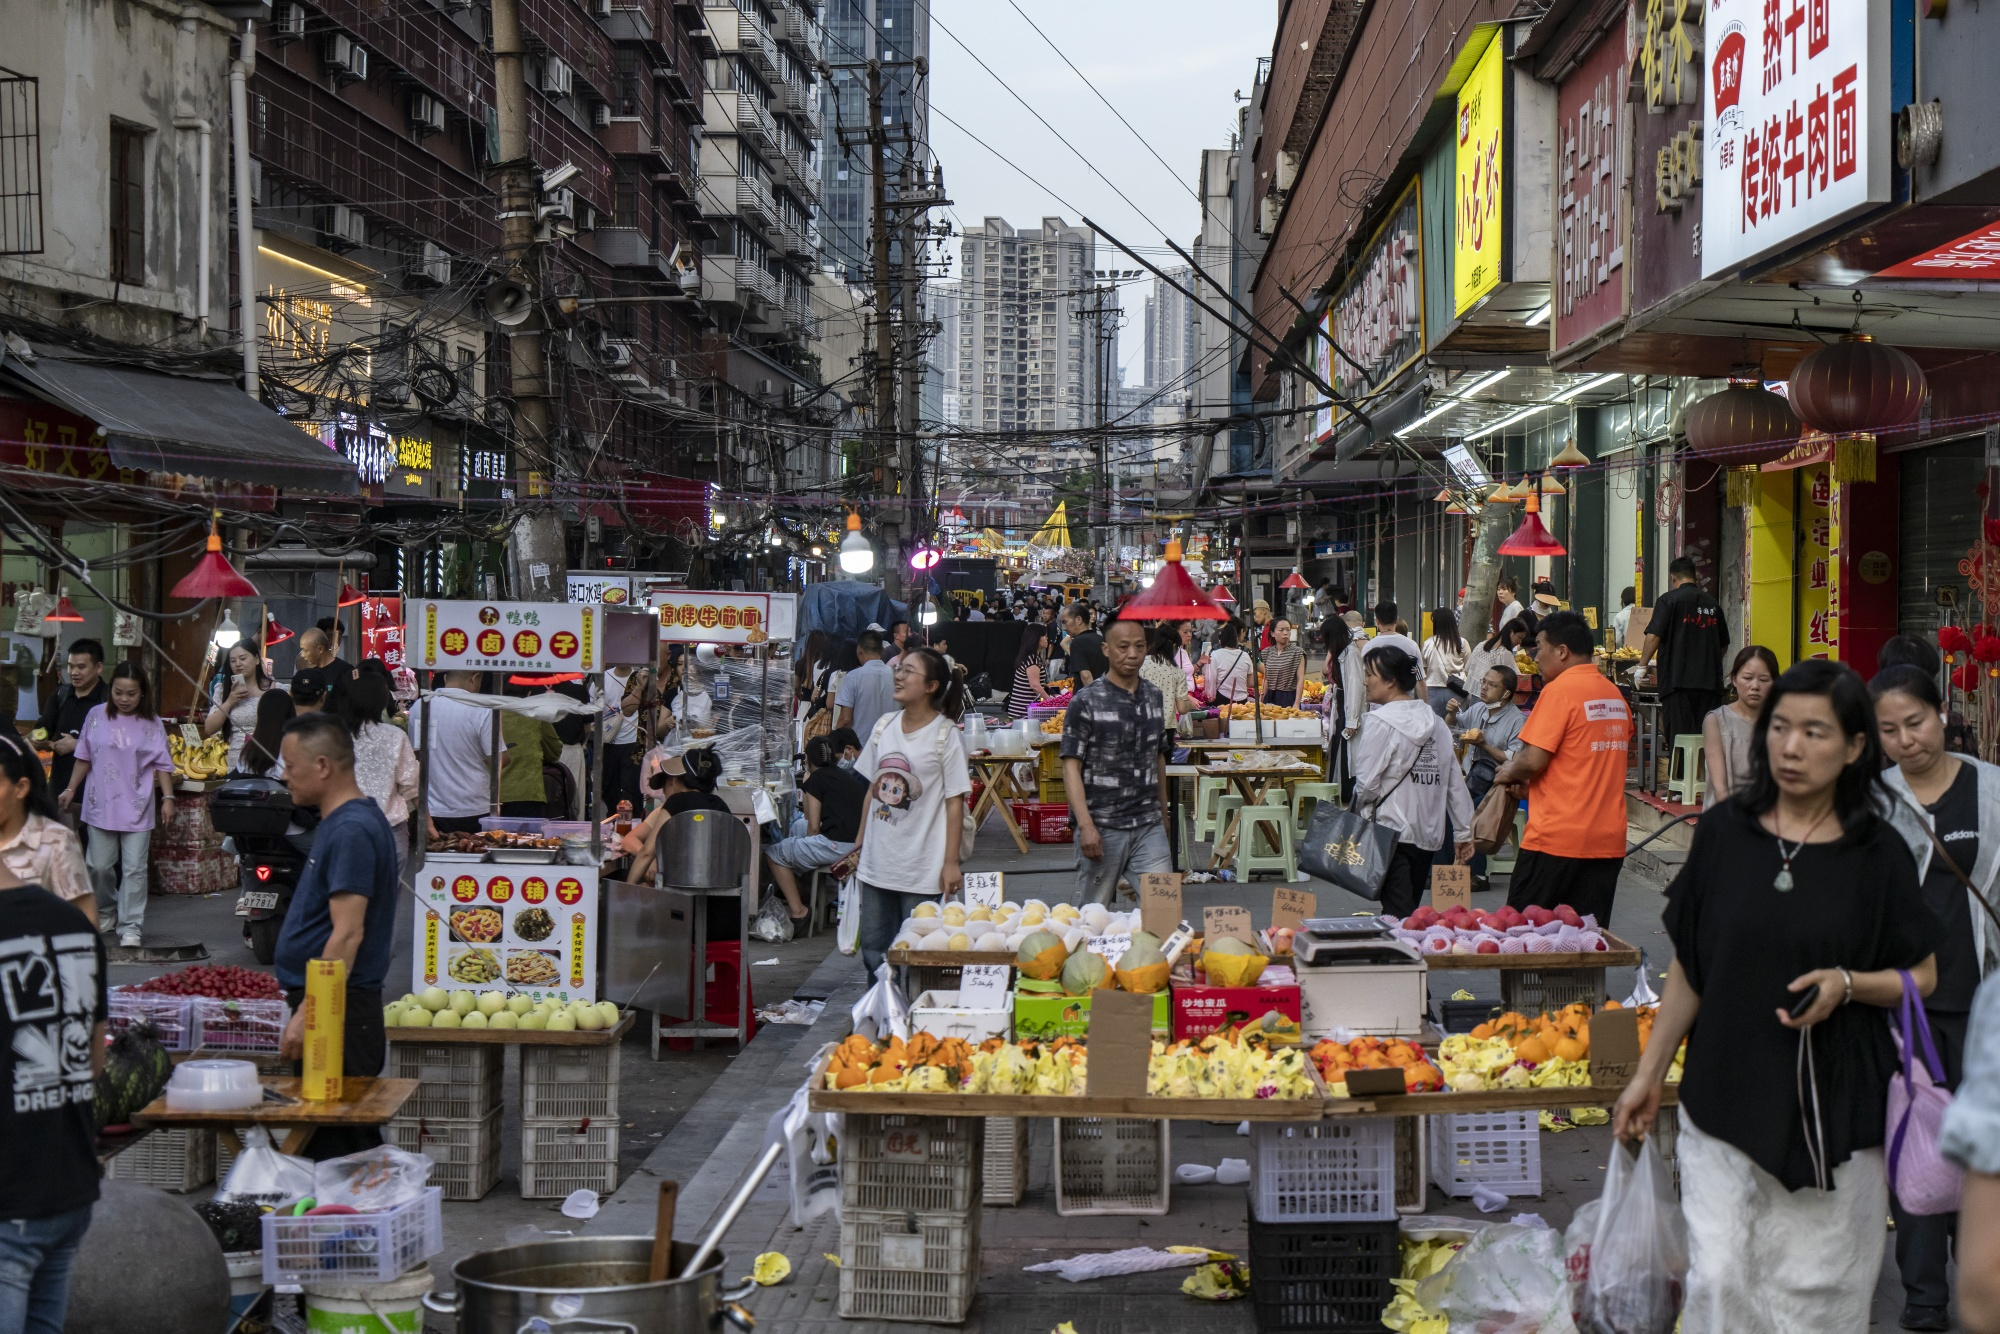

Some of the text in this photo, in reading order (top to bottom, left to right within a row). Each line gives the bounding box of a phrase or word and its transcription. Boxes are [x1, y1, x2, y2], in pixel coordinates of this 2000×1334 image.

[1719, 137, 1735, 171] 6号店
[1740, 63, 1858, 235] 传统牛肉面
[24, 418, 135, 485] 好又多
[505, 609, 541, 627] 鸭鸭
[660, 604, 760, 628] 凉拌牛筋面
[444, 632, 575, 655] 鲜卤铺子
[466, 658, 552, 669] 打造更健康的绿色食品
[1943, 830, 1975, 842] adidas
[966, 873, 999, 889] 皇冠梨
[1437, 868, 1464, 881] 红富士
[455, 879, 580, 901] 鲜卤铺子
[1277, 889, 1305, 904] 红富士
[1181, 998, 1227, 1008] 沙地蜜瓜
